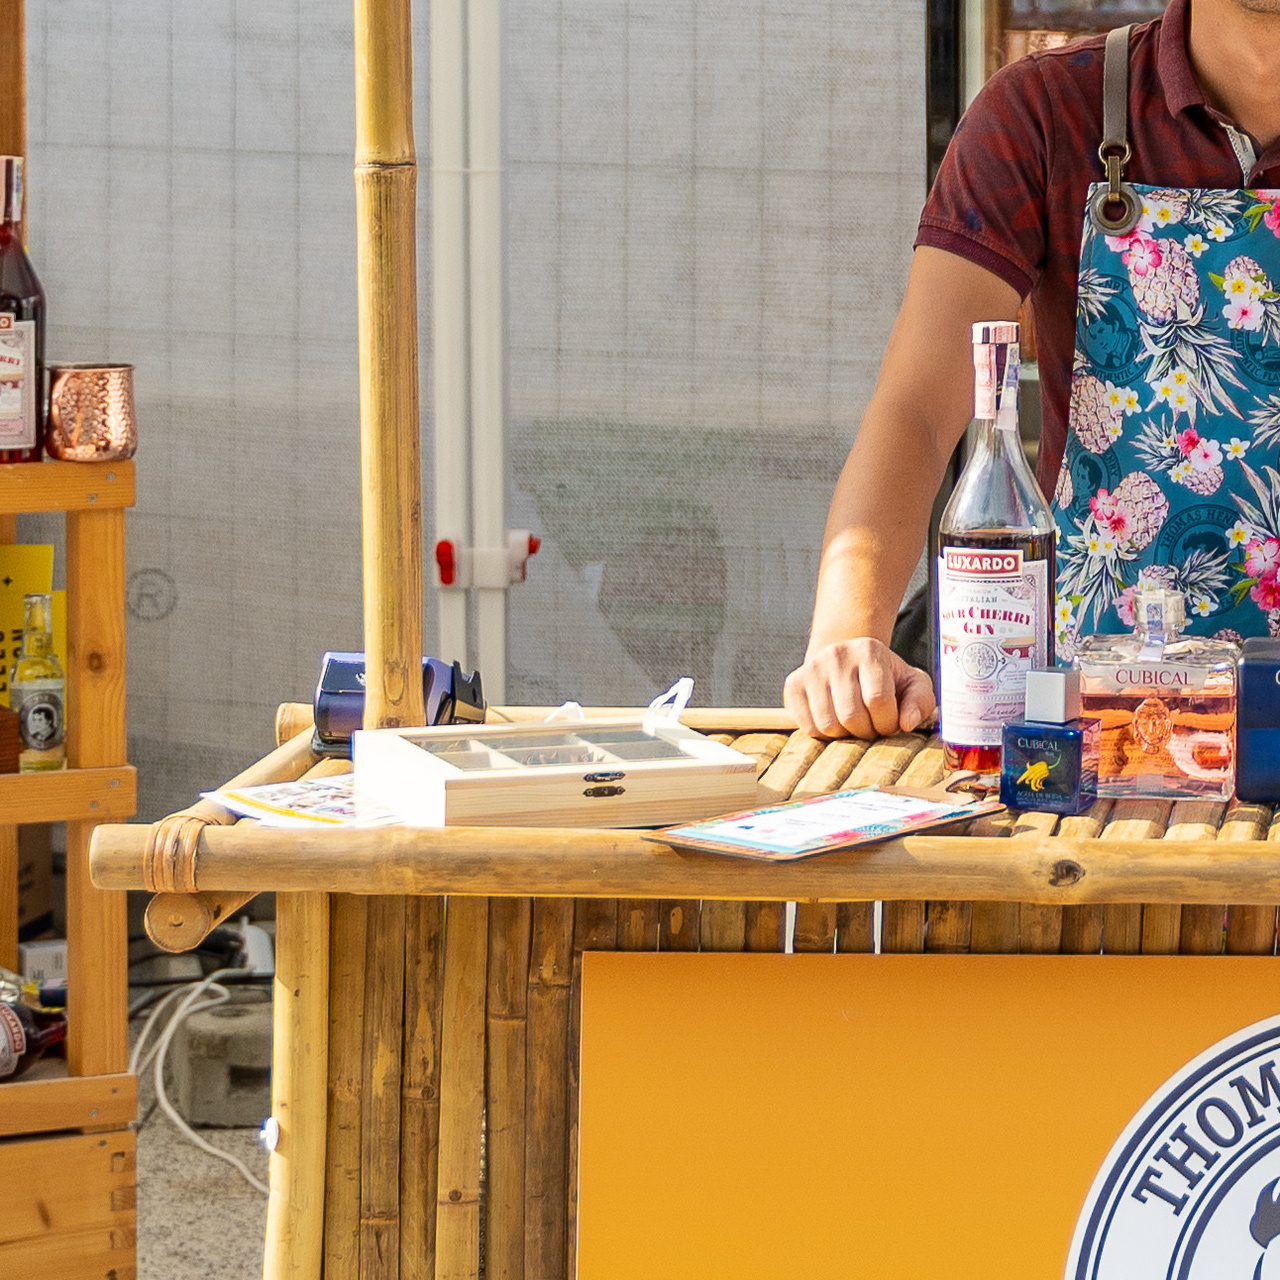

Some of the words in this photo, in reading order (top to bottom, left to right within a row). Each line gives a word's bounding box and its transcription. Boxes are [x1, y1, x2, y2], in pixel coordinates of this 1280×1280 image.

[1160, 509, 1202, 549] THOMAS
[947, 554, 1016, 571] LUXARDO
[963, 620, 996, 636] GIN
[1115, 669, 1194, 686] CUBICAL
[1017, 737, 1061, 752] CUBICAL
